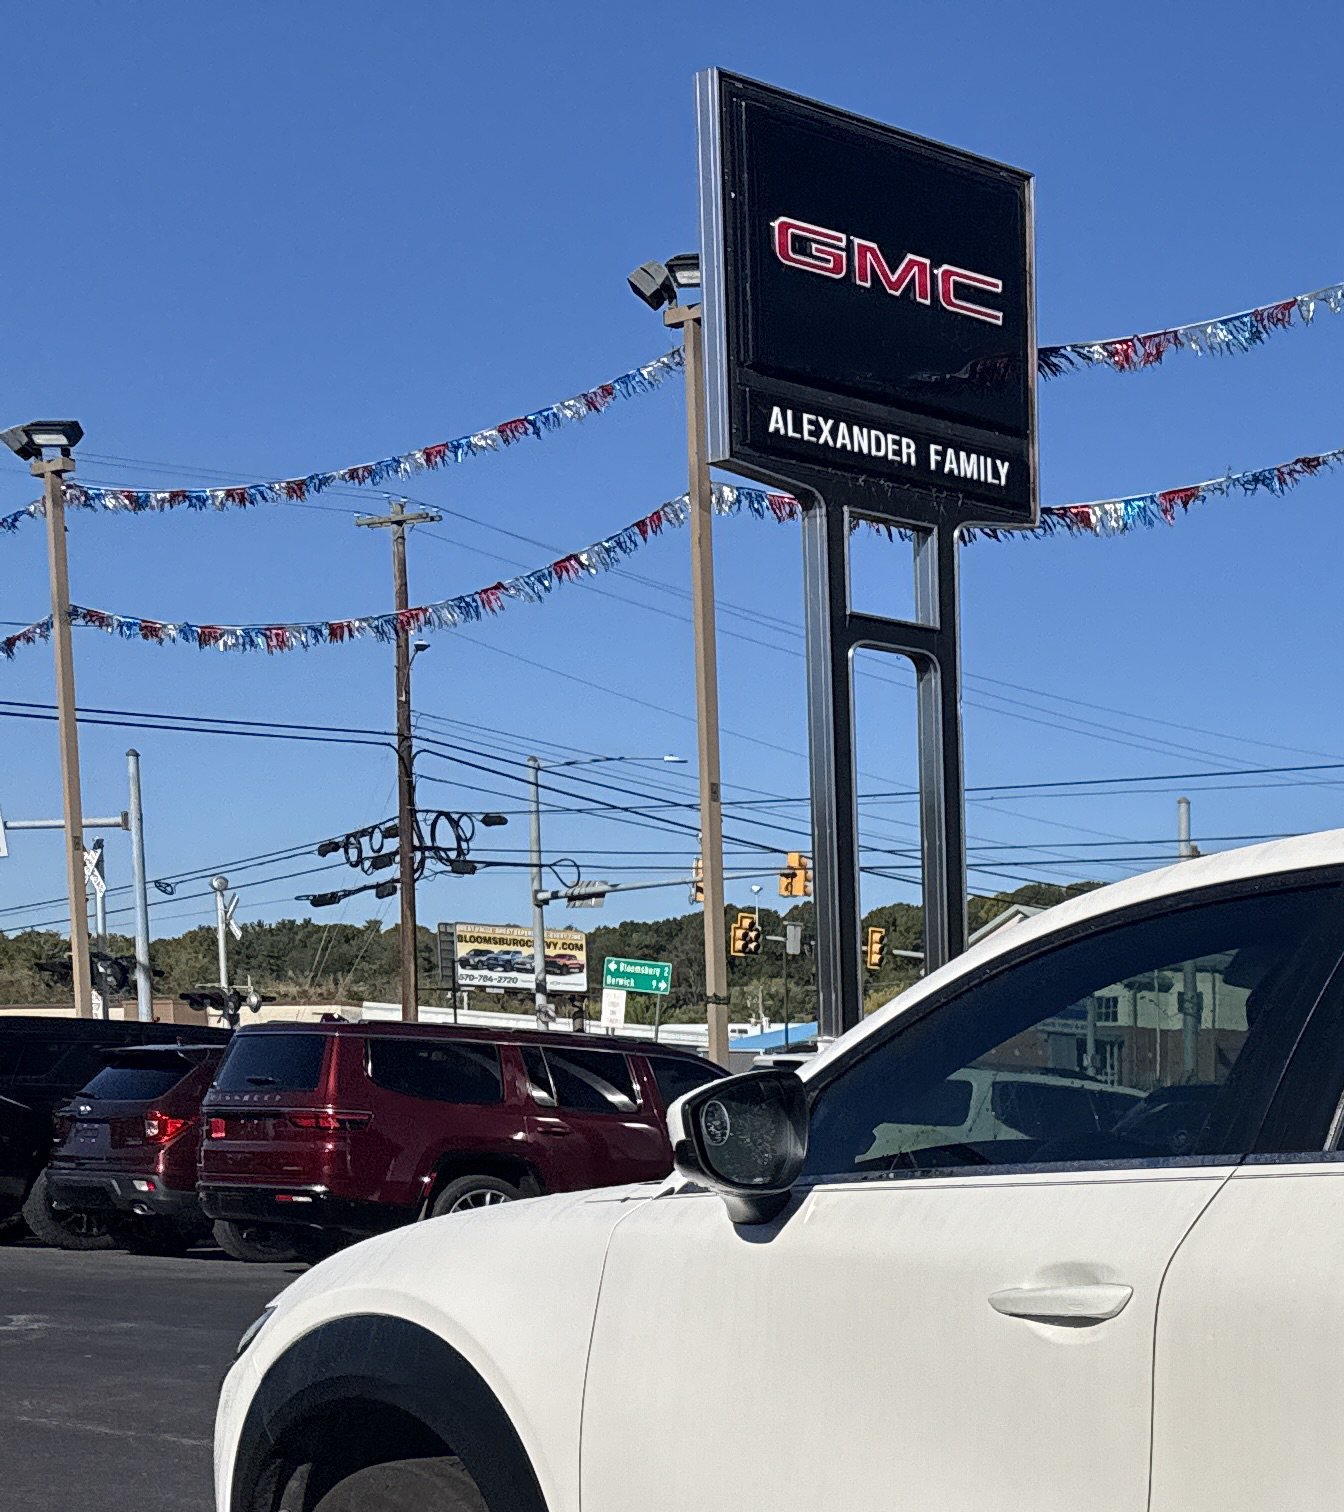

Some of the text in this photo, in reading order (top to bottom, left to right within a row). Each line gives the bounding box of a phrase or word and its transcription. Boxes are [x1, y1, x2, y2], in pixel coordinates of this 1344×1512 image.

[774, 216, 1003, 326] GMC
[768, 405, 1010, 487] ALEXANDER FAMILY
[457, 933, 584, 952] BLOOMSBURGCVY.COM
[620, 962, 669, 977] Bloomsburg 2
